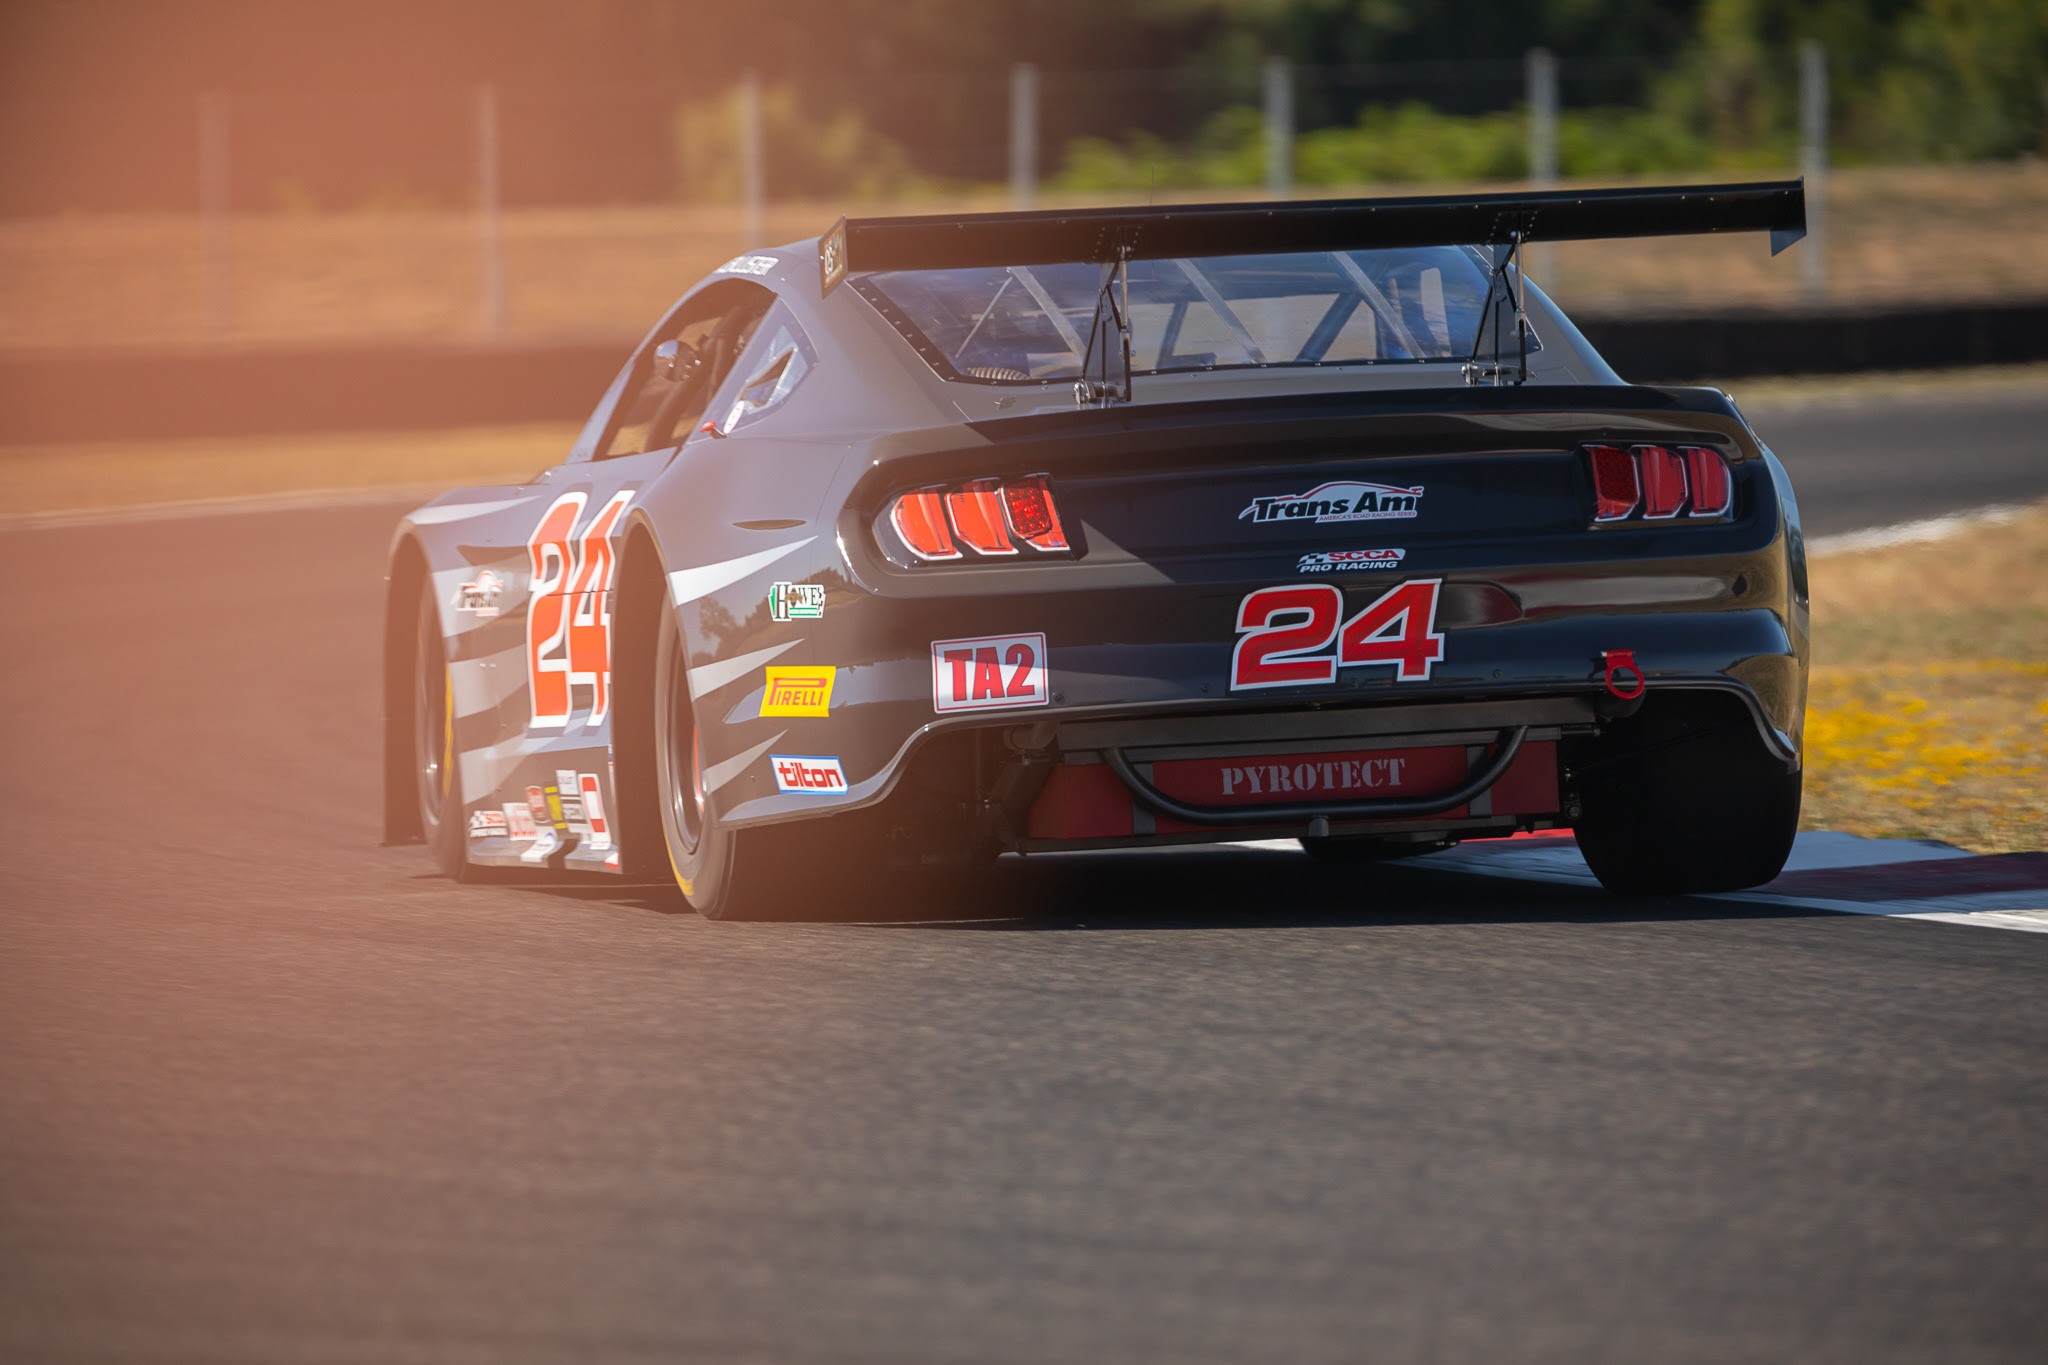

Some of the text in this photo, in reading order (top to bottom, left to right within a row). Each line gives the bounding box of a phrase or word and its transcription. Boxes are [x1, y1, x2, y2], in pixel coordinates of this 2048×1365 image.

[1255, 492, 1415, 520] Trans Am
[1300, 561, 1398, 573] PRO RACING
[1328, 549, 1400, 561] SCCA
[1231, 578, 1444, 691] 24
[944, 643, 1035, 702] TA2
[768, 677, 827, 706] PIRELLI
[778, 761, 843, 788] tilton
[1220, 758, 1405, 796] PYROTECT
